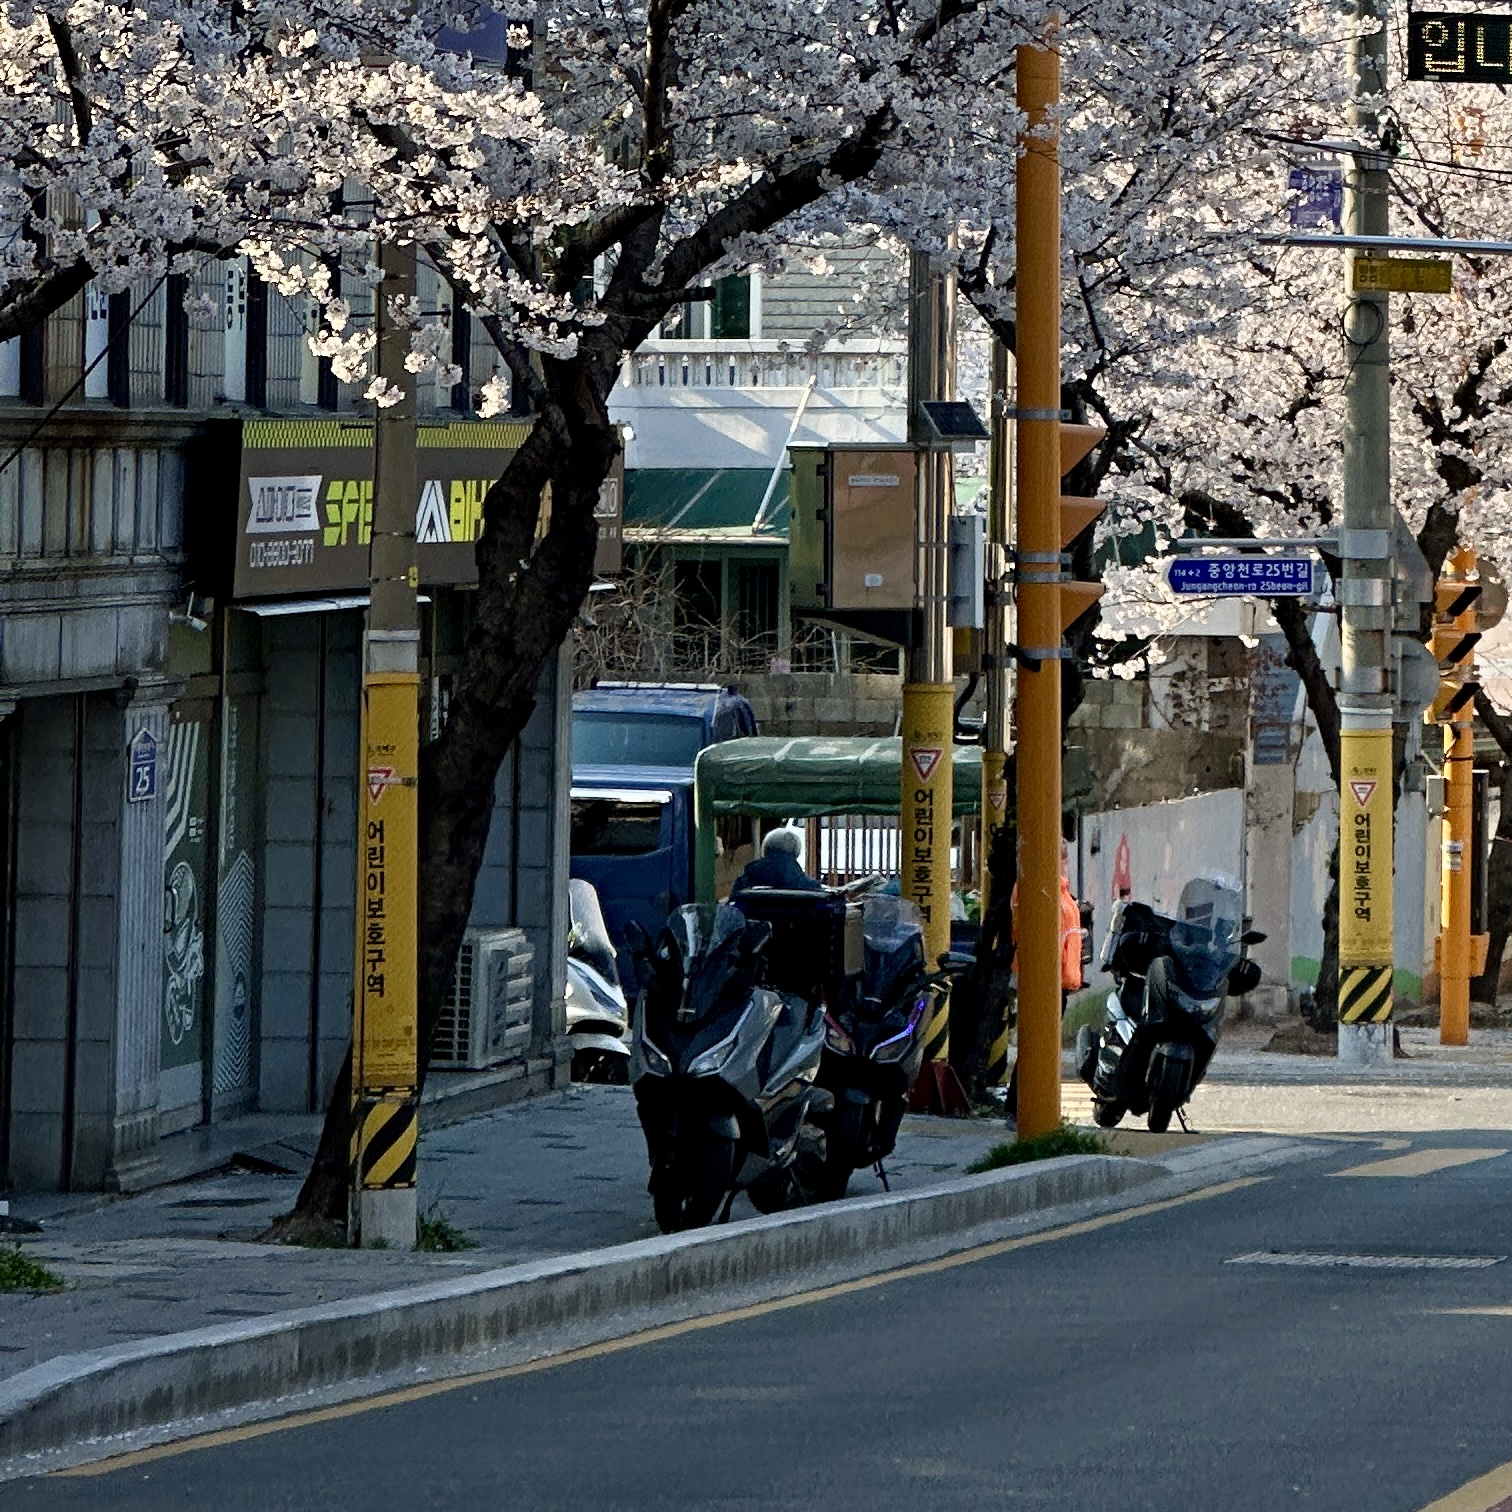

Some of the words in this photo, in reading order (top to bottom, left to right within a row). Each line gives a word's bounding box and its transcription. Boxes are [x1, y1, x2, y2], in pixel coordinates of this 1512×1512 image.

[1208, 563, 1308, 579] 중앙천로25번길
[136, 767, 149, 795] 25
[367, 819, 386, 998] 어린이보호구역
[911, 789, 933, 923] 어린이보호구역
[1354, 813, 1371, 922] 어린이보호구역
